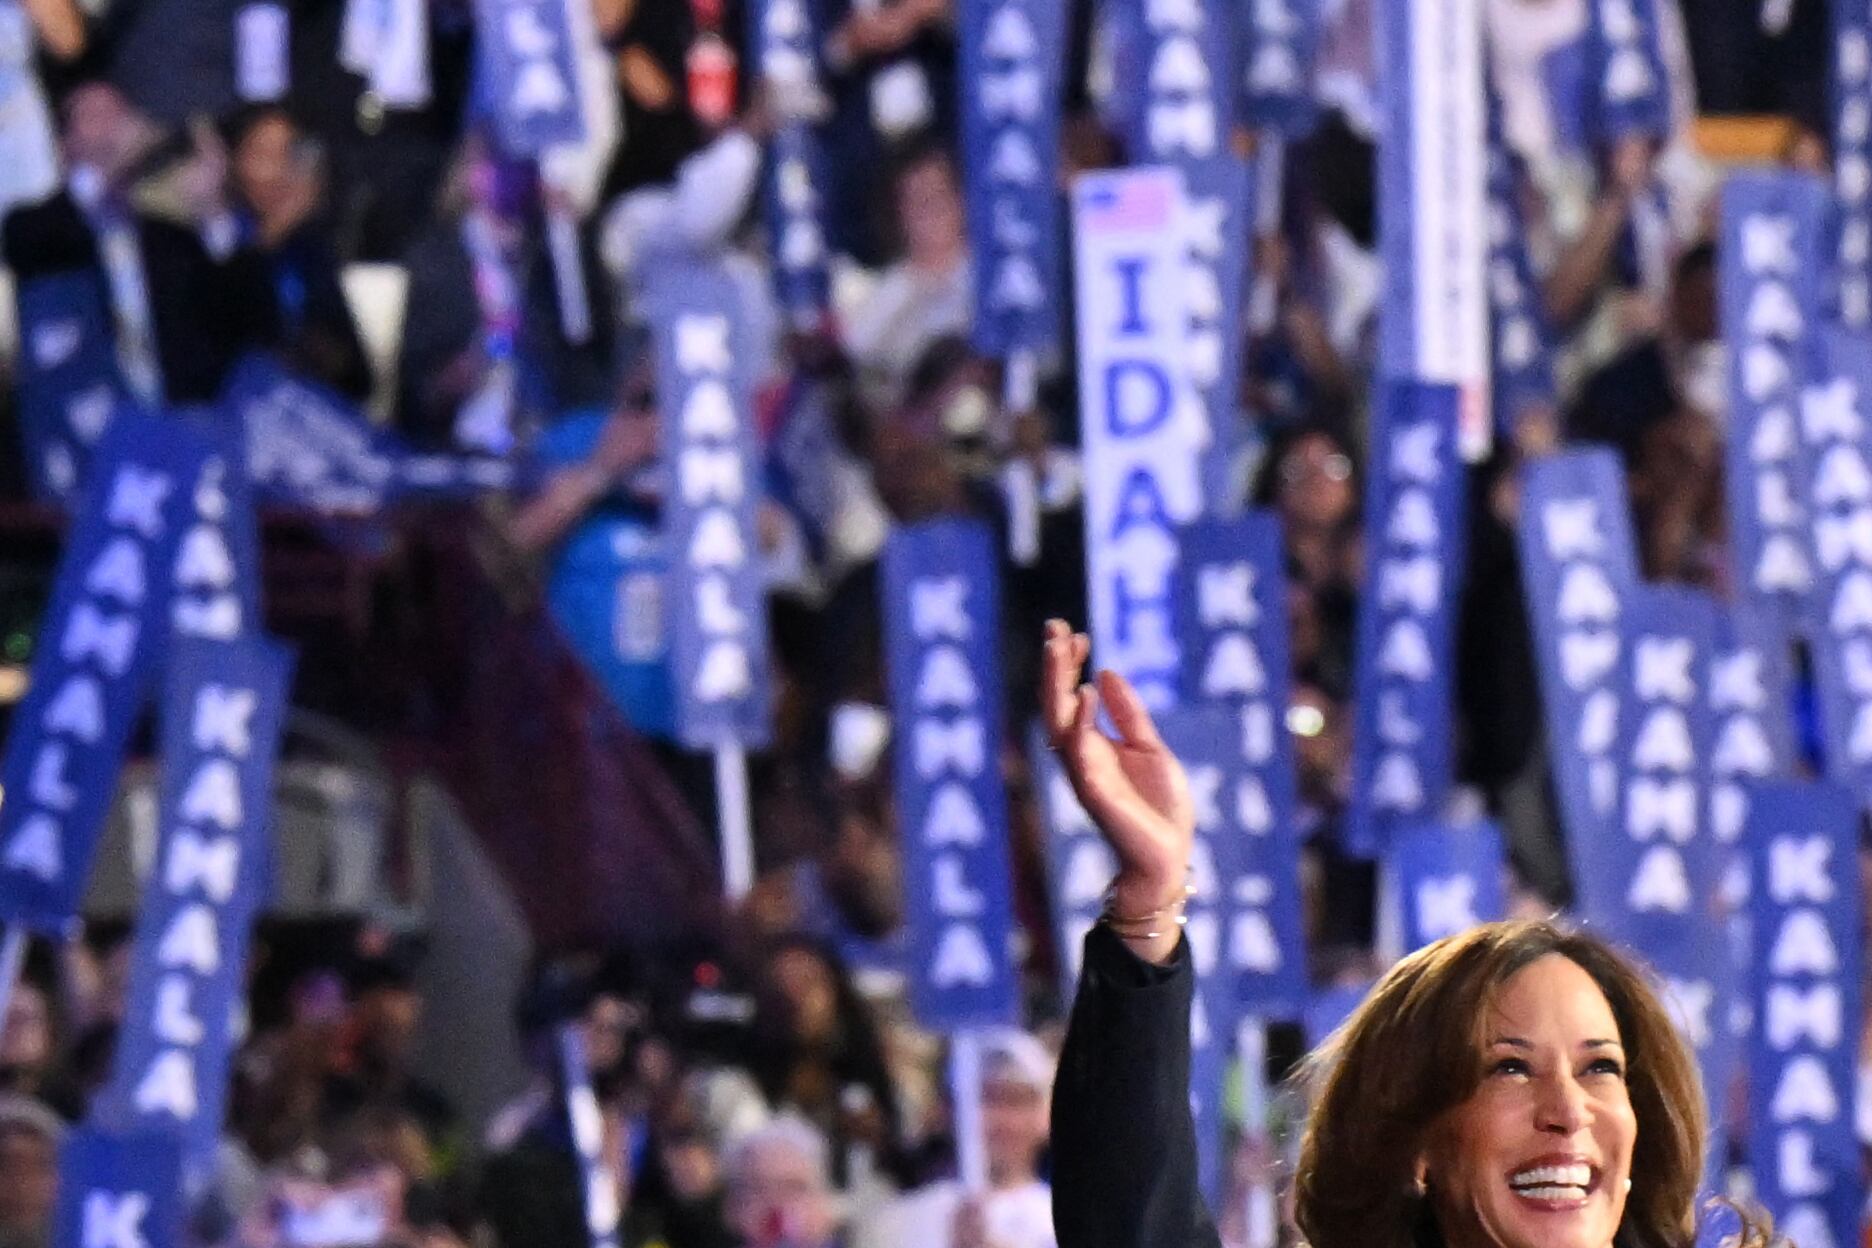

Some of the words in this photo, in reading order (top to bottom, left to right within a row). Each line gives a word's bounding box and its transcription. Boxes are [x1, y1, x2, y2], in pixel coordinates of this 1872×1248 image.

[2, 462, 171, 882] KAMALA
[674, 313, 753, 700] KAMALA
[1371, 424, 1442, 811] KAMALA
[136, 683, 256, 1120] KAMALA
[909, 575, 994, 987] KAMALA
